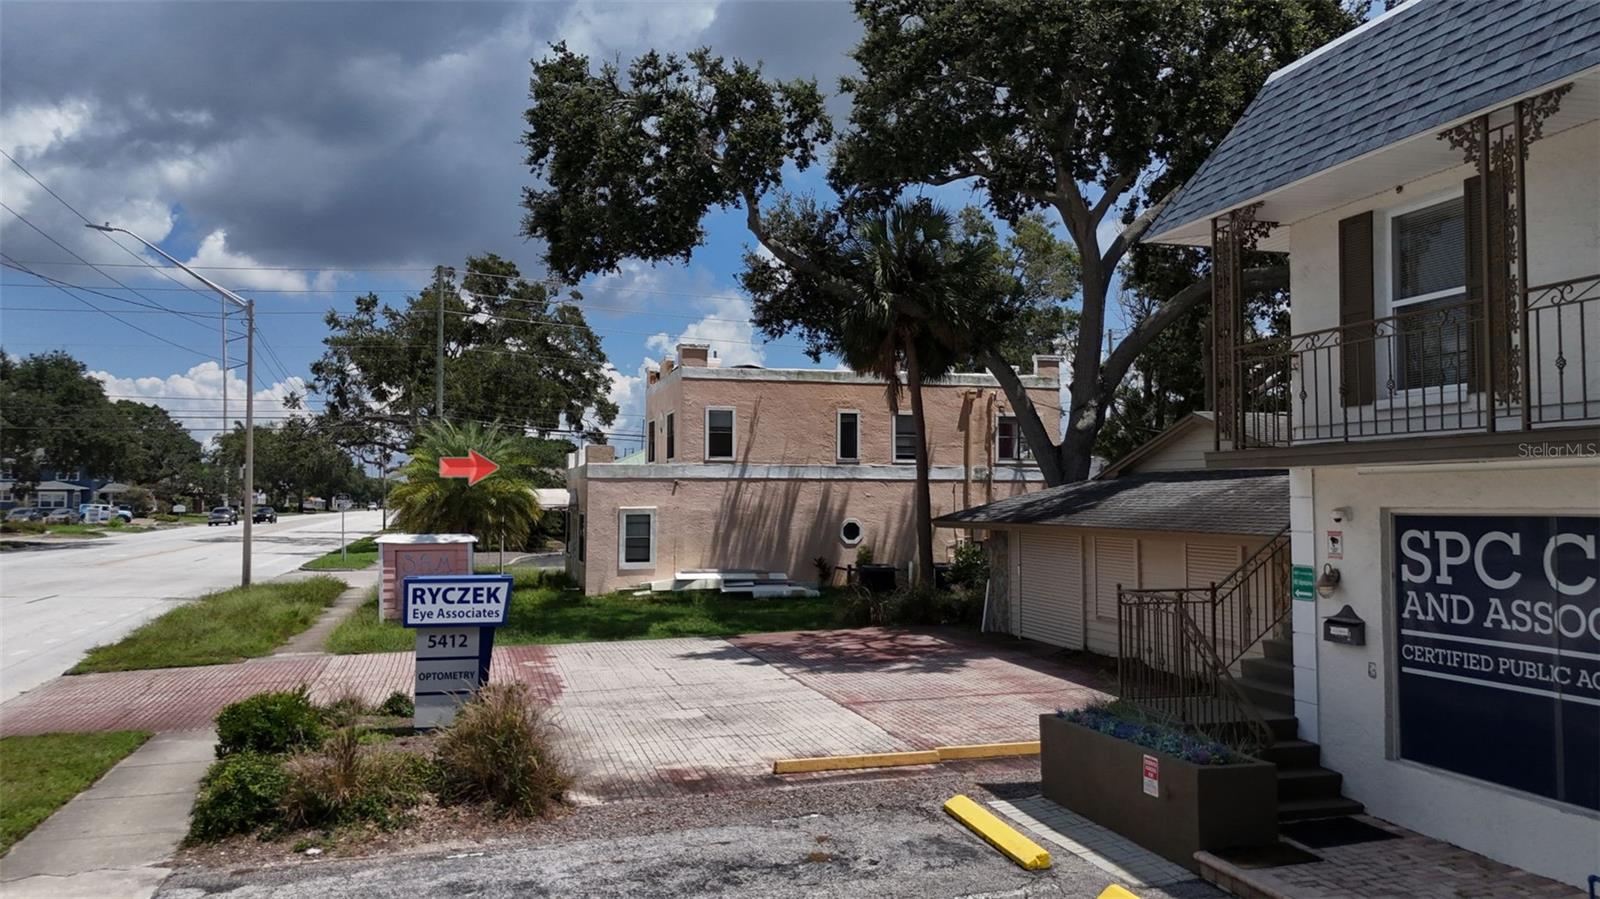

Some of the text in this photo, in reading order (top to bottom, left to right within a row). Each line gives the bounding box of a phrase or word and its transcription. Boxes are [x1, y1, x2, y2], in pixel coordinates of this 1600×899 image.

[1400, 529, 1522, 590] SPC
[412, 587, 501, 605] RYCZEK
[412, 607, 500, 621] Eye Associates
[1402, 591, 1475, 625] AND
[427, 634, 468, 648] 5412
[1402, 644, 1494, 672] CERTIFIED
[1498, 657, 1571, 685] PUBLIC
[418, 671, 476, 681] OPTOMETRY
